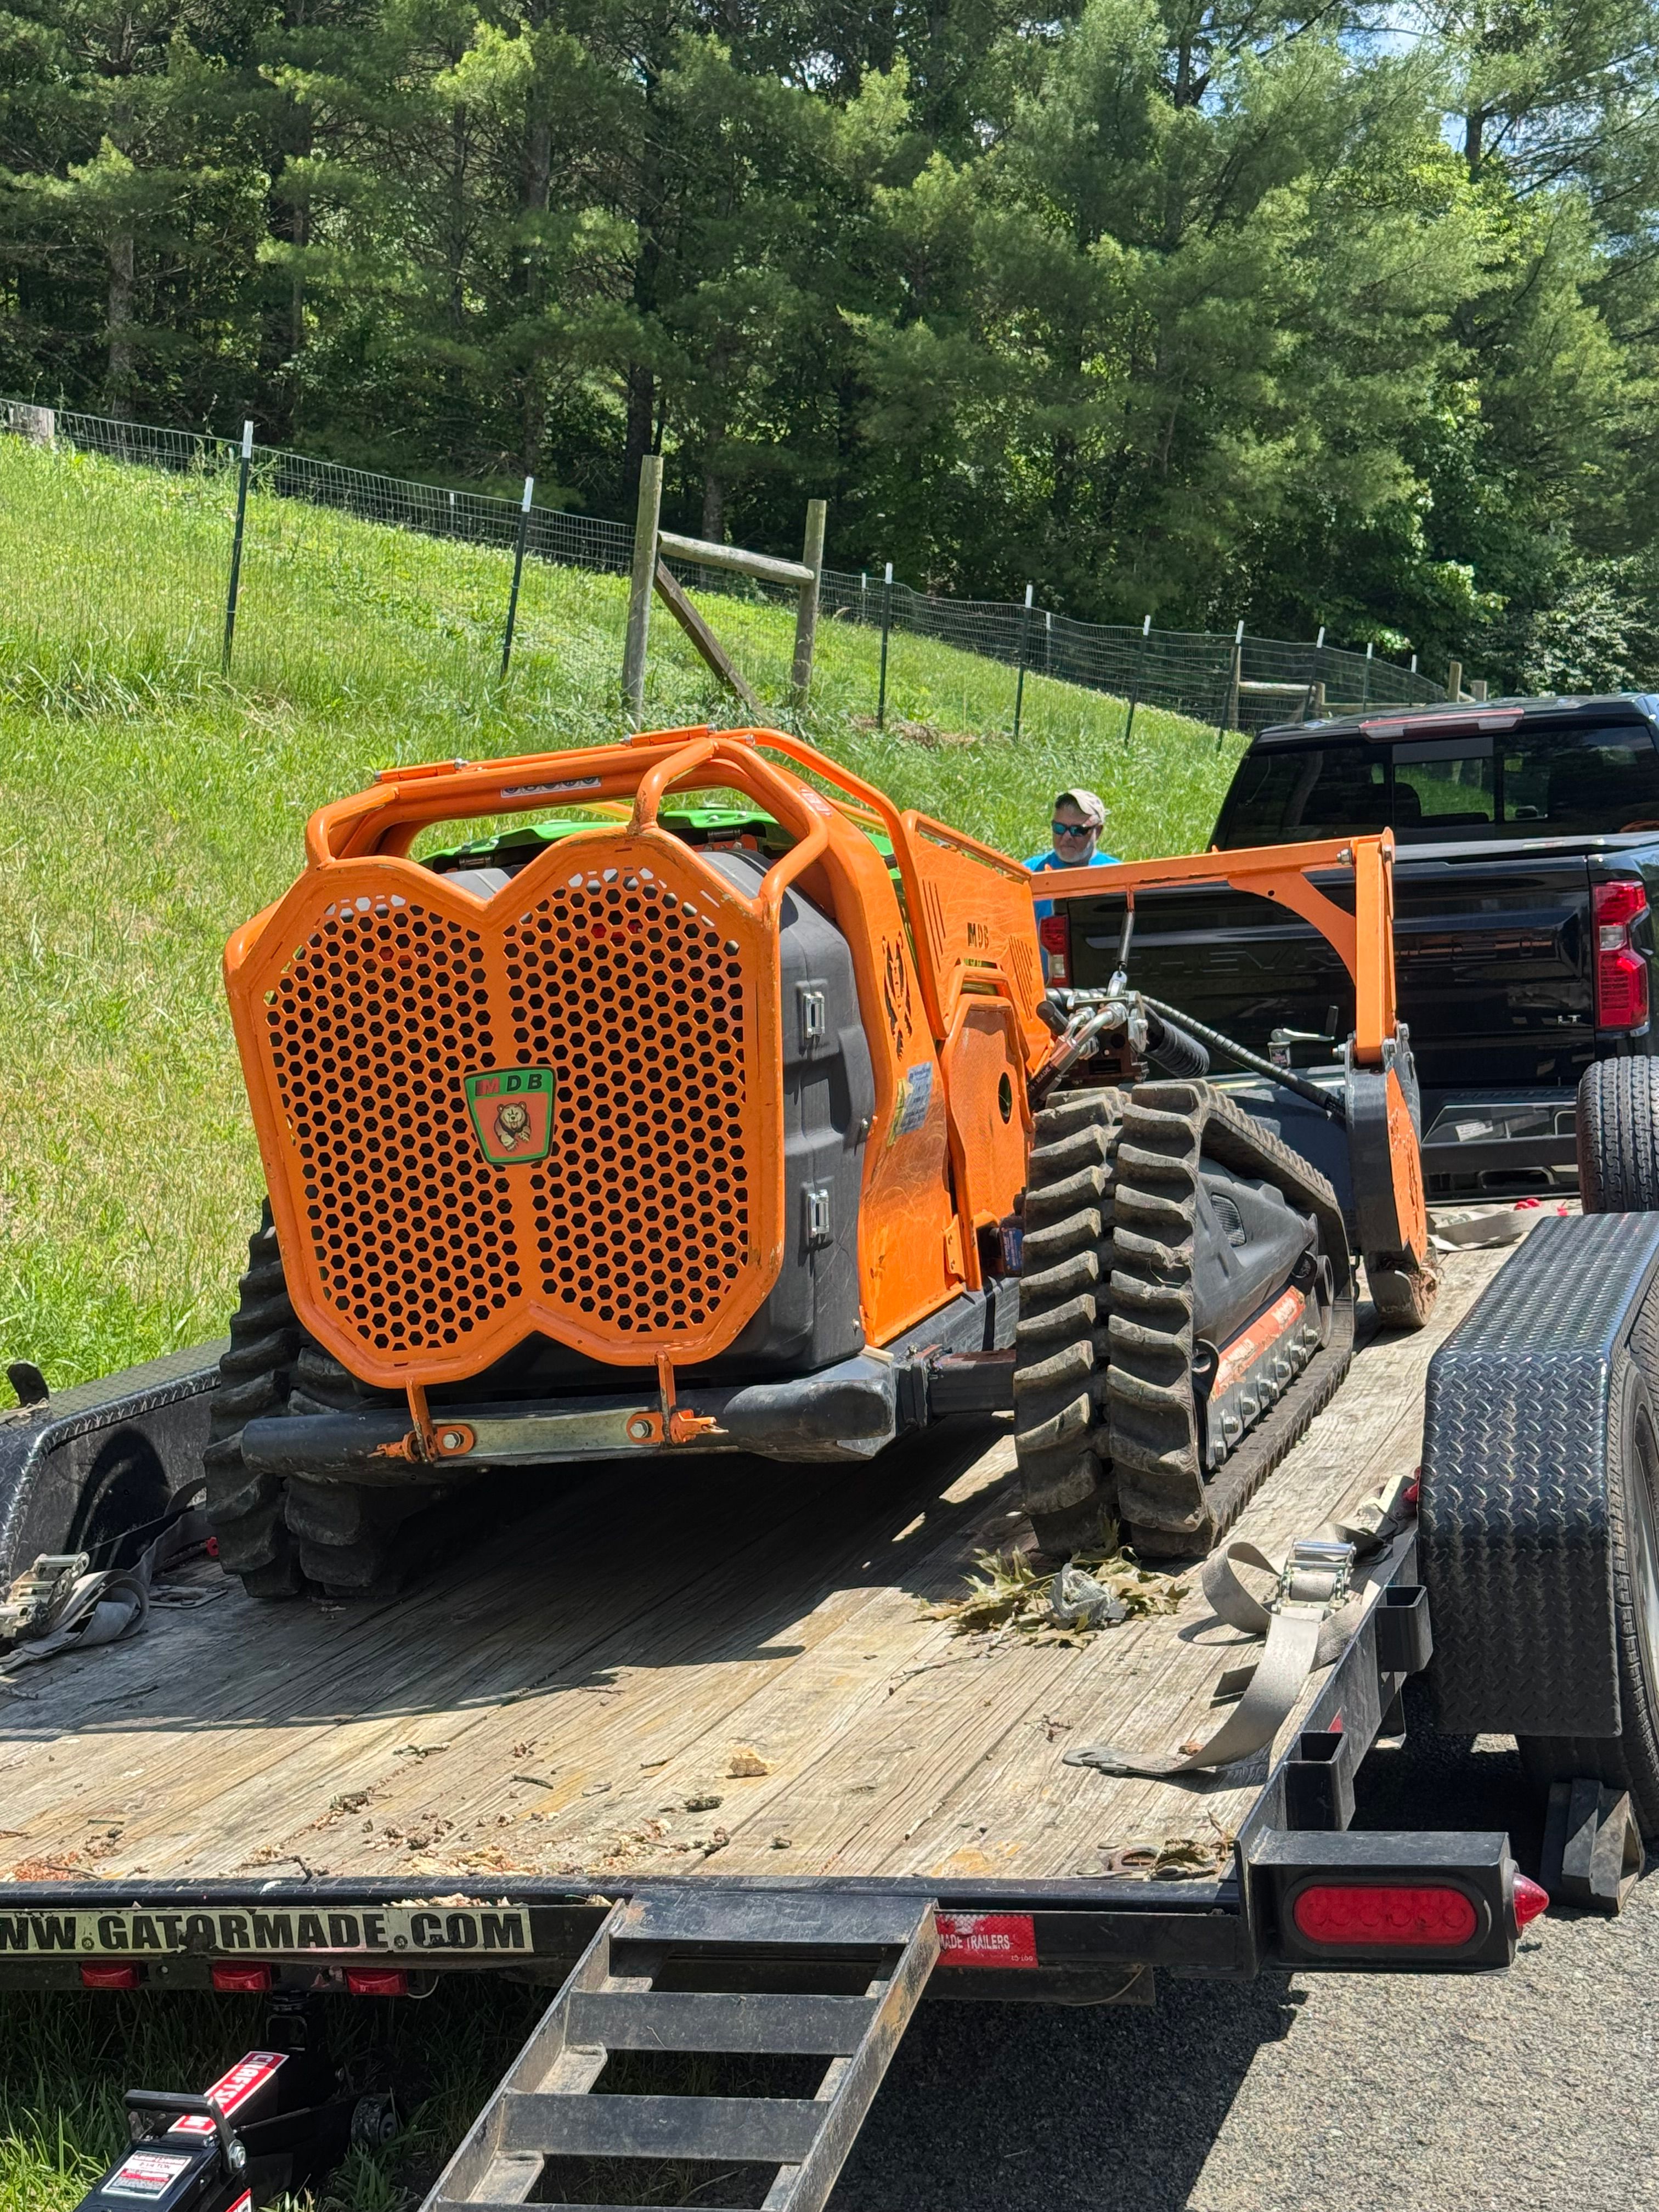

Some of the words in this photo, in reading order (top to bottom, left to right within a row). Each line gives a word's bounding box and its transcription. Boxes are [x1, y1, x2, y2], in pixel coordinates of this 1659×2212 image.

[967, 922, 989, 950] MDB
[1558, 1014, 1581, 1025] LT
[475, 1074, 543, 1096] MDB
[967, 1934, 1010, 1950] TRAILERS
